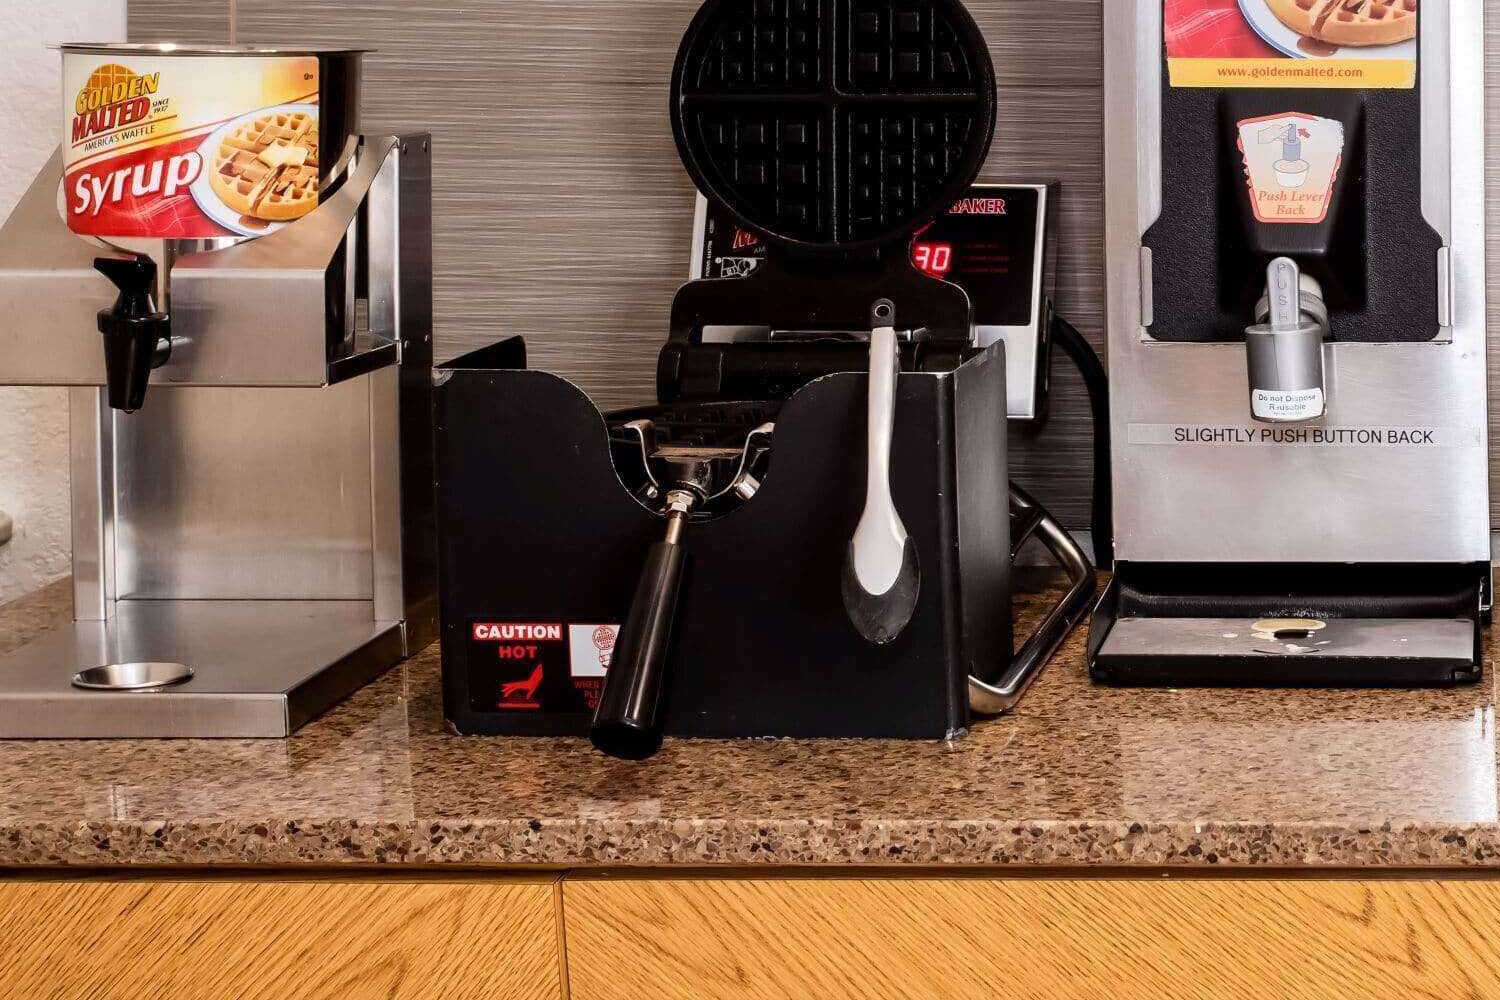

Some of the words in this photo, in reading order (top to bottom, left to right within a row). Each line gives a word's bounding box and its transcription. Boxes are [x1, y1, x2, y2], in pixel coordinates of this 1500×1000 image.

[1217, 66, 1363, 79] www.goldenmalted.com
[76, 72, 160, 116] GOLDEN
[71, 96, 150, 144] MALTED
[84, 135, 120, 152] AMERICA'S
[121, 125, 156, 140] WAFFLE
[74, 151, 203, 216] Syrup
[1258, 190, 1287, 202] Push
[1291, 190, 1324, 202] Lever
[1276, 204, 1305, 215] Back
[1174, 427, 1256, 443] SLIGHTLY
[1261, 428, 1306, 443] PUSH
[1313, 429, 1382, 444] BUTTON
[1387, 430, 1434, 444] BACK
[475, 625, 561, 639] CAUTION
[499, 646, 538, 659] HOT
